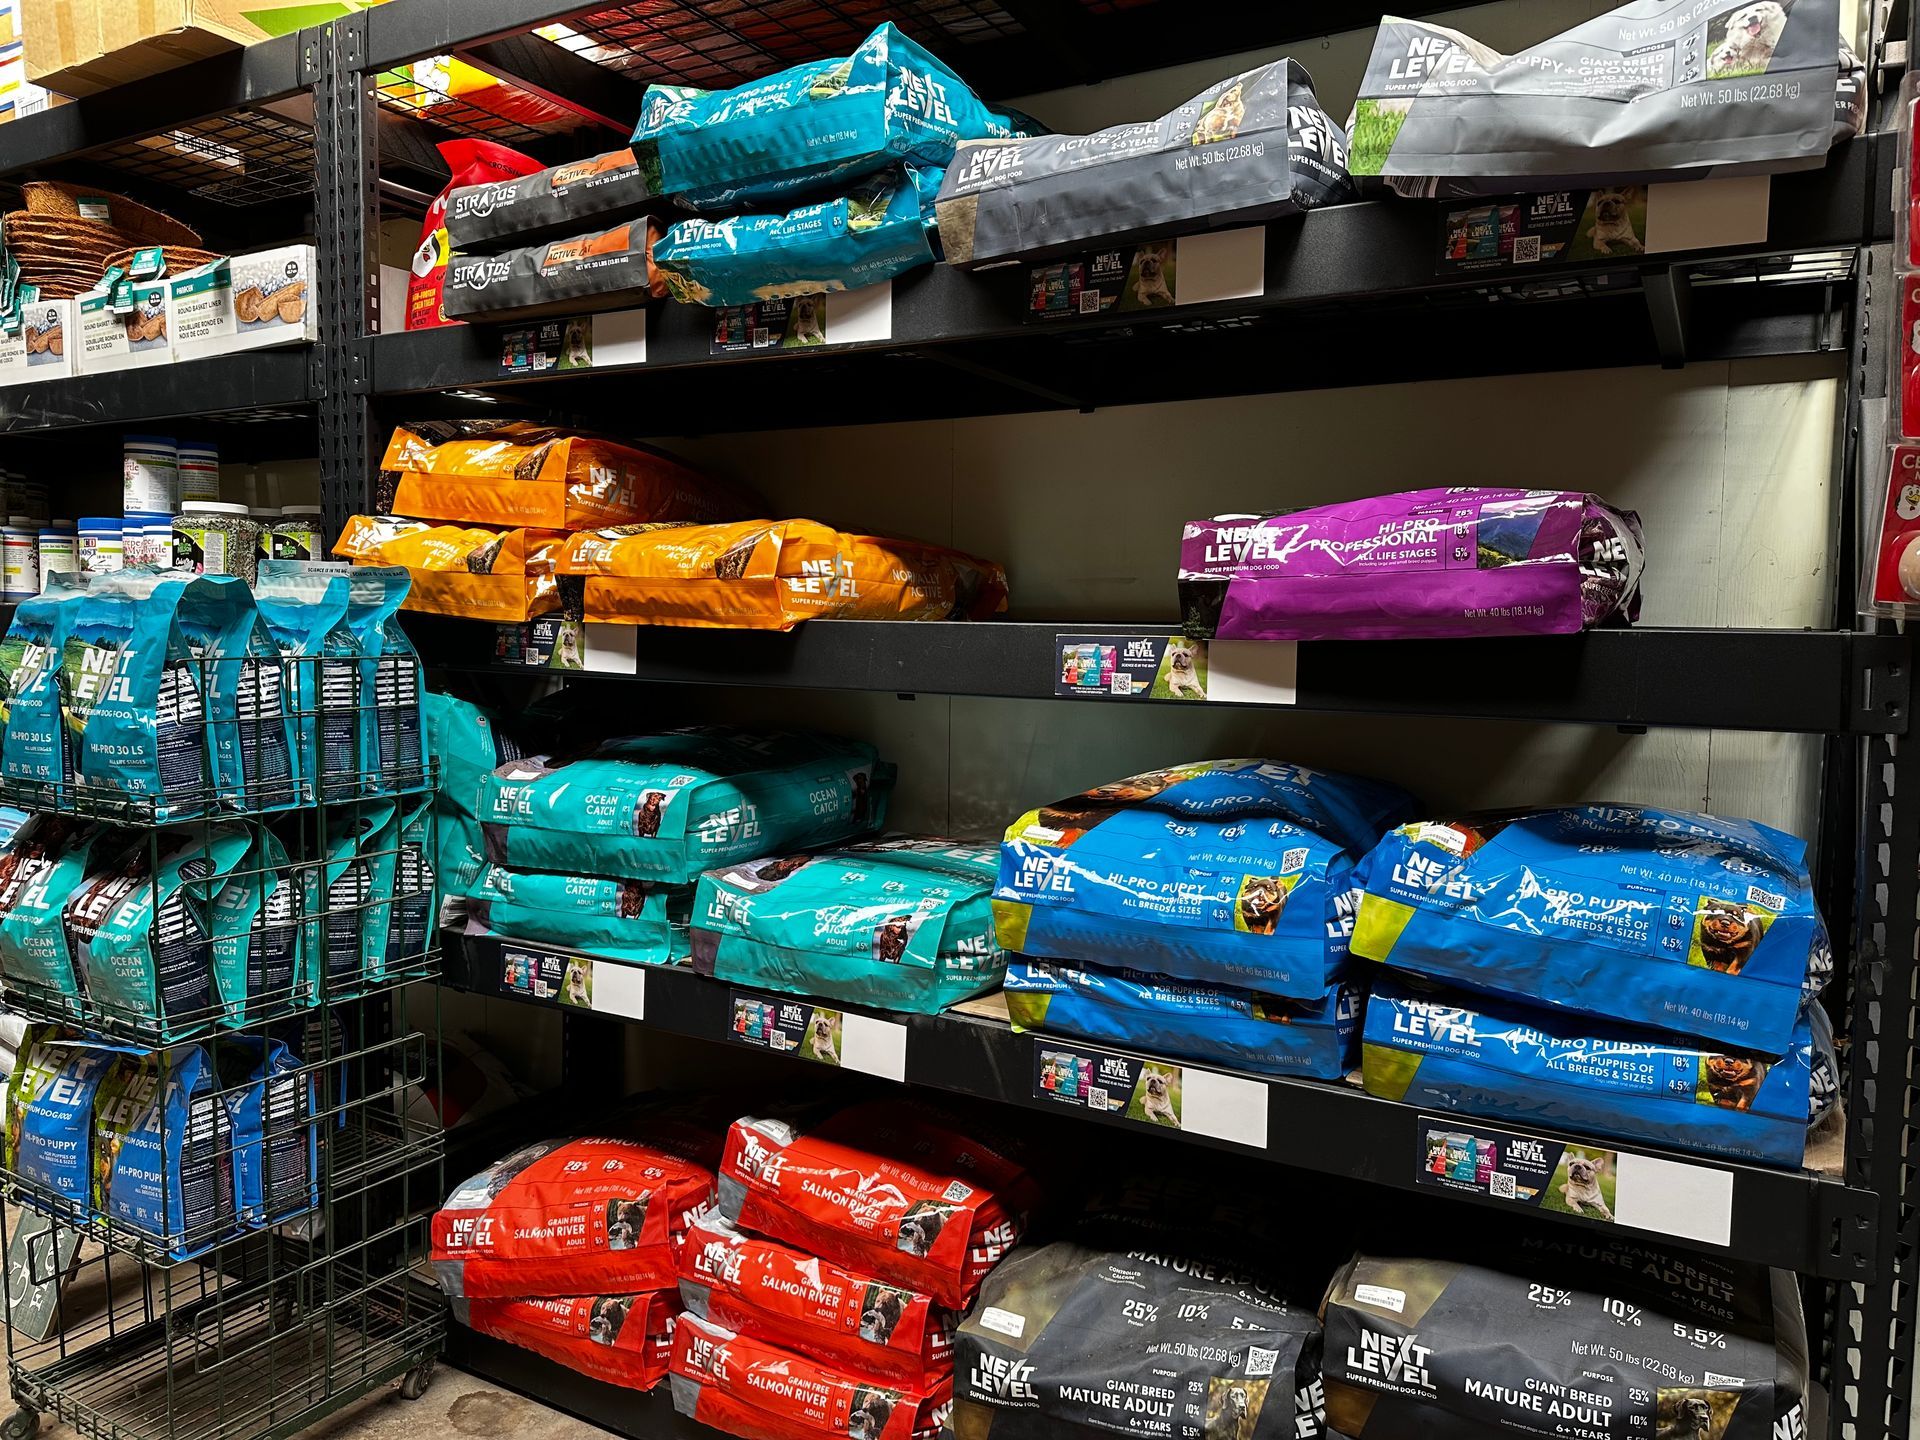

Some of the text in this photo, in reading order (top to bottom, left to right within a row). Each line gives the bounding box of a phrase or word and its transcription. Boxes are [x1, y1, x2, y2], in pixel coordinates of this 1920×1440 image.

[1631, 44, 1665, 55] PURPOSE
[1580, 53, 1664, 66] GIANT BREED
[900, 66, 946, 102] NEXT
[1385, 78, 1477, 91] SUPER PREMIUM DOG FOOD
[1681, 82, 1800, 107] Net Wt. 50 lbs (22.68 kg)
[1175, 143, 1264, 170] Net Wt. 50 lbs (22.68 kg)
[556, 168, 589, 182] ACTIVE
[958, 152, 1024, 184] LEVEL
[955, 170, 1023, 192] SUPER PREMIUM DOG FOOD
[456, 186, 517, 213] STRATOS
[1537, 191, 1570, 206] NEXT
[1531, 202, 1573, 214] LEVEL
[782, 219, 822, 236] LIFE STAGES
[548, 250, 576, 262] ACTIVE
[454, 261, 511, 282] STRATOS
[179, 322, 200, 332] DOUBLURE
[202, 319, 216, 327] RONDE
[1378, 518, 1440, 535] HI-PRO
[1310, 529, 1439, 552] PROFESSIONAL
[572, 550, 613, 562] LEVEL
[1205, 544, 1284, 563] LEVEL
[801, 551, 854, 577] NEXT
[1204, 566, 1222, 574] SUPER
[1223, 565, 1248, 573] PREMIUM
[1262, 563, 1280, 571] FOOD
[791, 577, 860, 598] LEVEL
[911, 586, 942, 599] ACTIVE
[1128, 638, 1152, 650] NEXT
[1124, 649, 1155, 657] LEVEL
[91, 744, 144, 755] HI-PRO 30 LS
[128, 779, 146, 789] 4.5%
[500, 785, 535, 800] NEXT
[809, 787, 837, 804] OCEAN
[493, 798, 533, 815] LEVEL
[585, 795, 618, 807] OCEAN
[813, 800, 840, 816] CATCH
[1182, 795, 1253, 810] HI-PRO
[586, 805, 615, 816] CATCH
[701, 821, 761, 844] LEVEL
[1014, 871, 1075, 892] LEVEL
[1620, 864, 1738, 896] Net Wt. 40 lbs (18.14 kg)
[565, 883, 596, 896] CATCH
[1162, 883, 1206, 894] PUPPY
[1123, 898, 1202, 915] ALL BREEDS & SIZES
[1212, 908, 1230, 919] 4.5%
[1667, 915, 1685, 927] 18%
[23, 936, 54, 947] OCEAN
[826, 938, 847, 947] ADULT
[1661, 935, 1684, 951] 4.5%
[28, 946, 56, 957] CATCH
[110, 955, 142, 966] OCEAN
[115, 966, 145, 977] CATCH
[1546, 1060, 1654, 1085] ALL BREEDS & SIZES
[1589, 1056, 1654, 1074] PUPPIES OF
[1668, 1079, 1691, 1093] 4.5%
[1512, 1140, 1544, 1152] NEXT
[1506, 1148, 1546, 1162] LEVEL
[57, 1177, 74, 1188] 4.5%
[800, 1179, 881, 1220] SALMON RIVER
[453, 1214, 495, 1233] NEXT
[548, 1215, 586, 1226] GRAIN FREE
[514, 1224, 585, 1239] SALMON RIVER
[446, 1232, 494, 1247] LEVEL
[566, 1237, 586, 1247] ADULT
[1108, 1266, 1141, 1278] CONTROLLED
[761, 1274, 840, 1308] SALMON RIVER
[1527, 1283, 1572, 1307] 25%
[545, 1300, 571, 1316] RIVER
[816, 1308, 838, 1319] ADULT
[1122, 1299, 1210, 1322] 25% 10%
[1602, 1297, 1642, 1328] 10%
[552, 1316, 570, 1327] ADULT
[1127, 1319, 1144, 1327] Protein
[1616, 1319, 1626, 1327] Fat
[1672, 1323, 1727, 1350] 5.5%
[1360, 1329, 1433, 1368] NEXT
[980, 1352, 1037, 1382] NEXT
[1152, 1369, 1177, 1378] PURPOSE
[1347, 1345, 1437, 1390] LEVEL
[971, 1368, 1039, 1400] LEVEL
[1582, 1371, 1614, 1383] PURPOSE
[746, 1373, 827, 1408] SALMON RIVER
[788, 1376, 830, 1395] GRAIN FREE
[1106, 1380, 1176, 1400] GIANT BREED
[1188, 1380, 1204, 1392] 25%
[1345, 1372, 1437, 1400] SUPER PREMIUM DOG FOOD
[1524, 1377, 1613, 1408] GIANT BREED
[1059, 1386, 1174, 1418] MATURE ADULT
[1465, 1378, 1612, 1428] MATURE ADULT
[1628, 1388, 1649, 1404] 25%
[804, 1408, 825, 1420] ADULT
[834, 1416, 843, 1426] 5%
[1629, 1414, 1648, 1427] 10%
[1130, 1418, 1171, 1432] 6+ YEARS
[1555, 1424, 1611, 1440] 6+ YEARS
